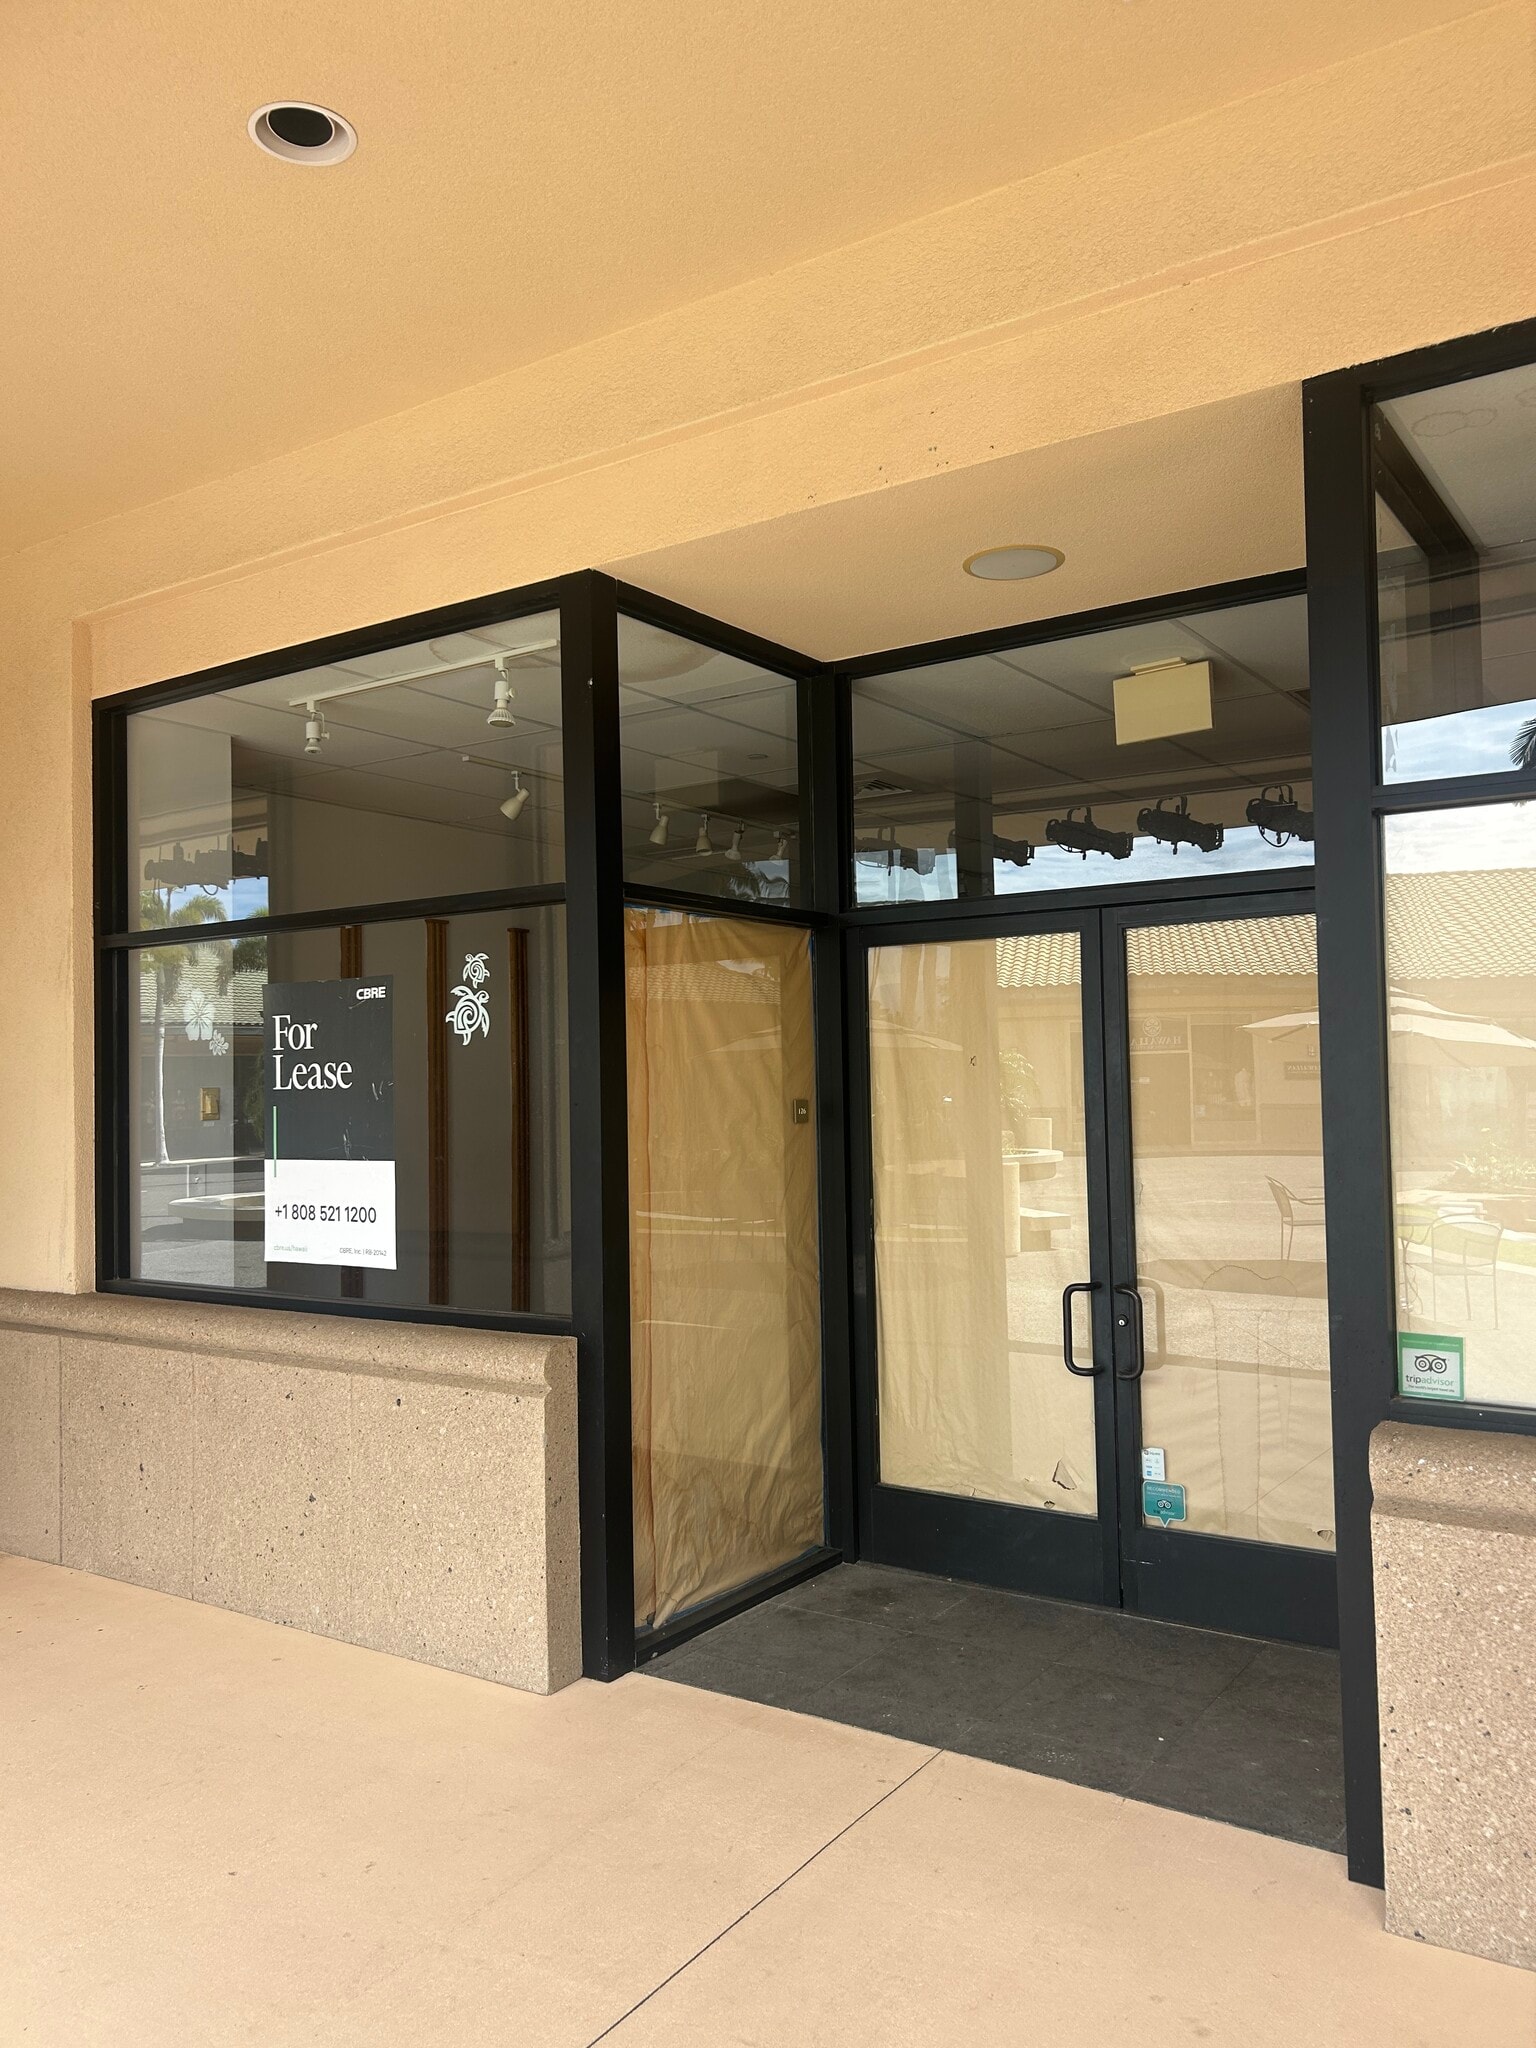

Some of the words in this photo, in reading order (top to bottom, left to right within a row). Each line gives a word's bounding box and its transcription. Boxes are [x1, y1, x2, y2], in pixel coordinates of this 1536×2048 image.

[356, 986, 387, 1000] CBRE
[272, 1014, 318, 1051] For
[272, 1054, 353, 1090] Lease
[275, 1204, 288, 1220] +1
[291, 1204, 316, 1221] 808
[319, 1206, 342, 1222] 521
[344, 1206, 377, 1223] 1200
[1406, 1374, 1455, 1386] tripadvisor
